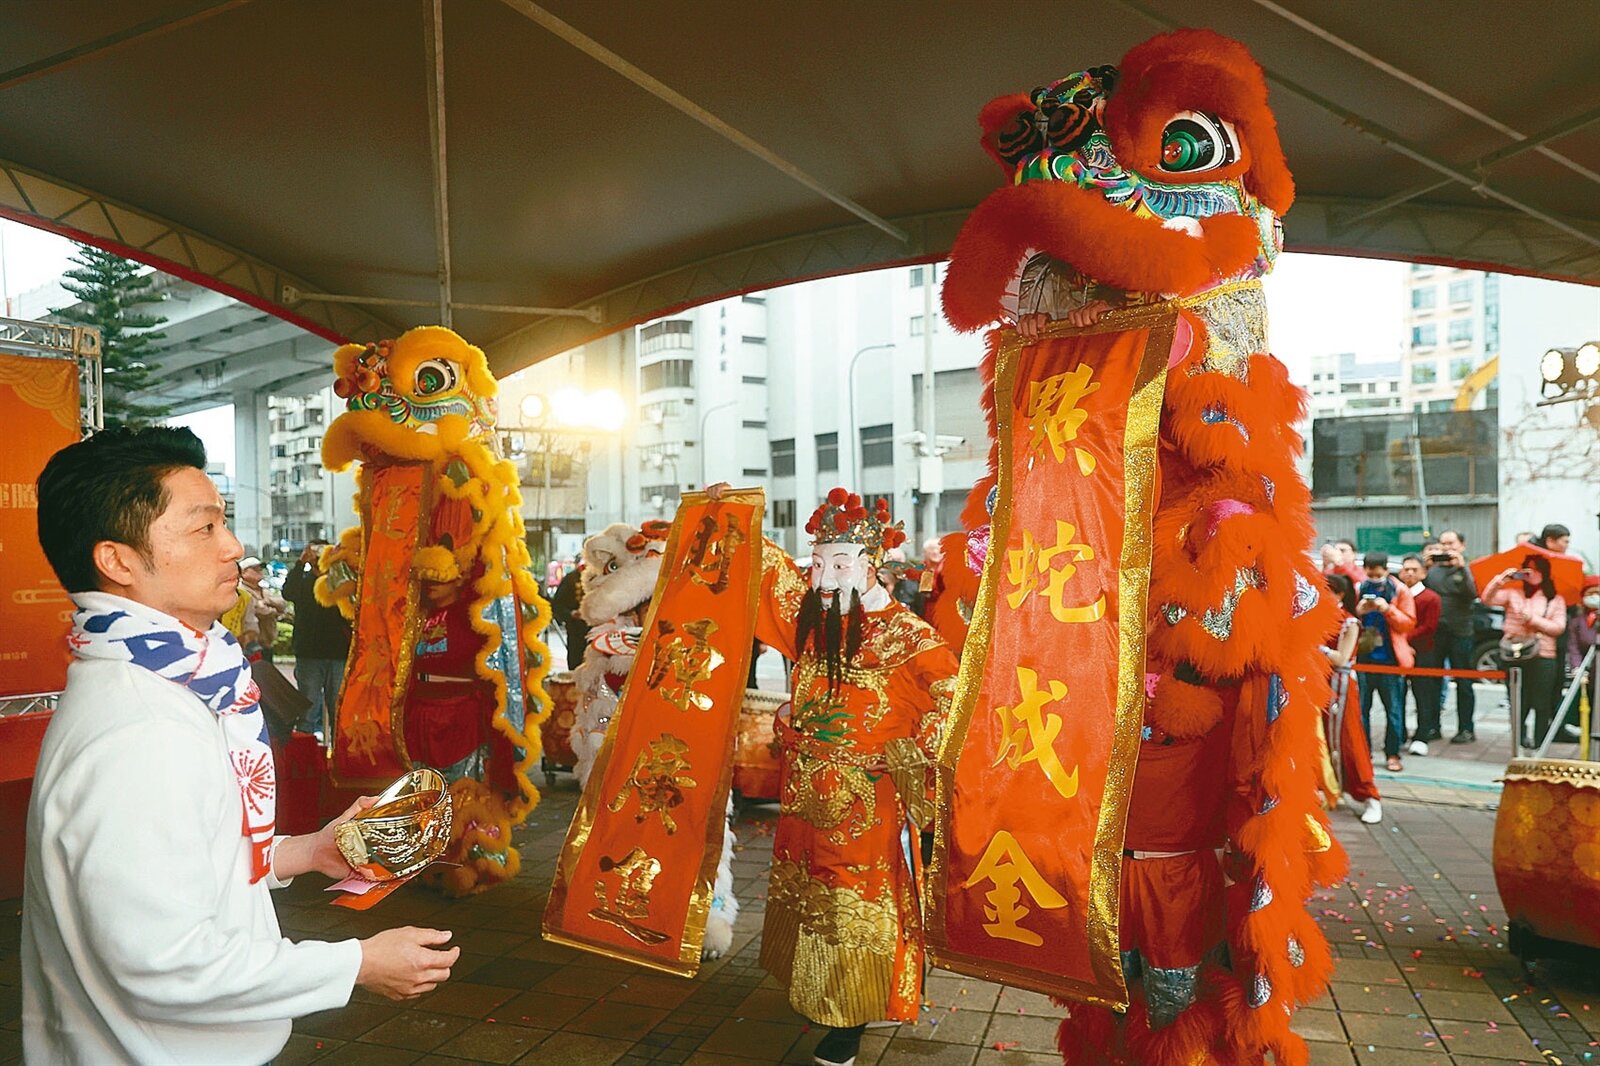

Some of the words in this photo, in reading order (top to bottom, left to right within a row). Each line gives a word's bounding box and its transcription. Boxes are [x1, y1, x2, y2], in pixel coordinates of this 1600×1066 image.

[587, 511, 746, 946] 財源廣進
[965, 362, 1107, 947] 點蛇成金
